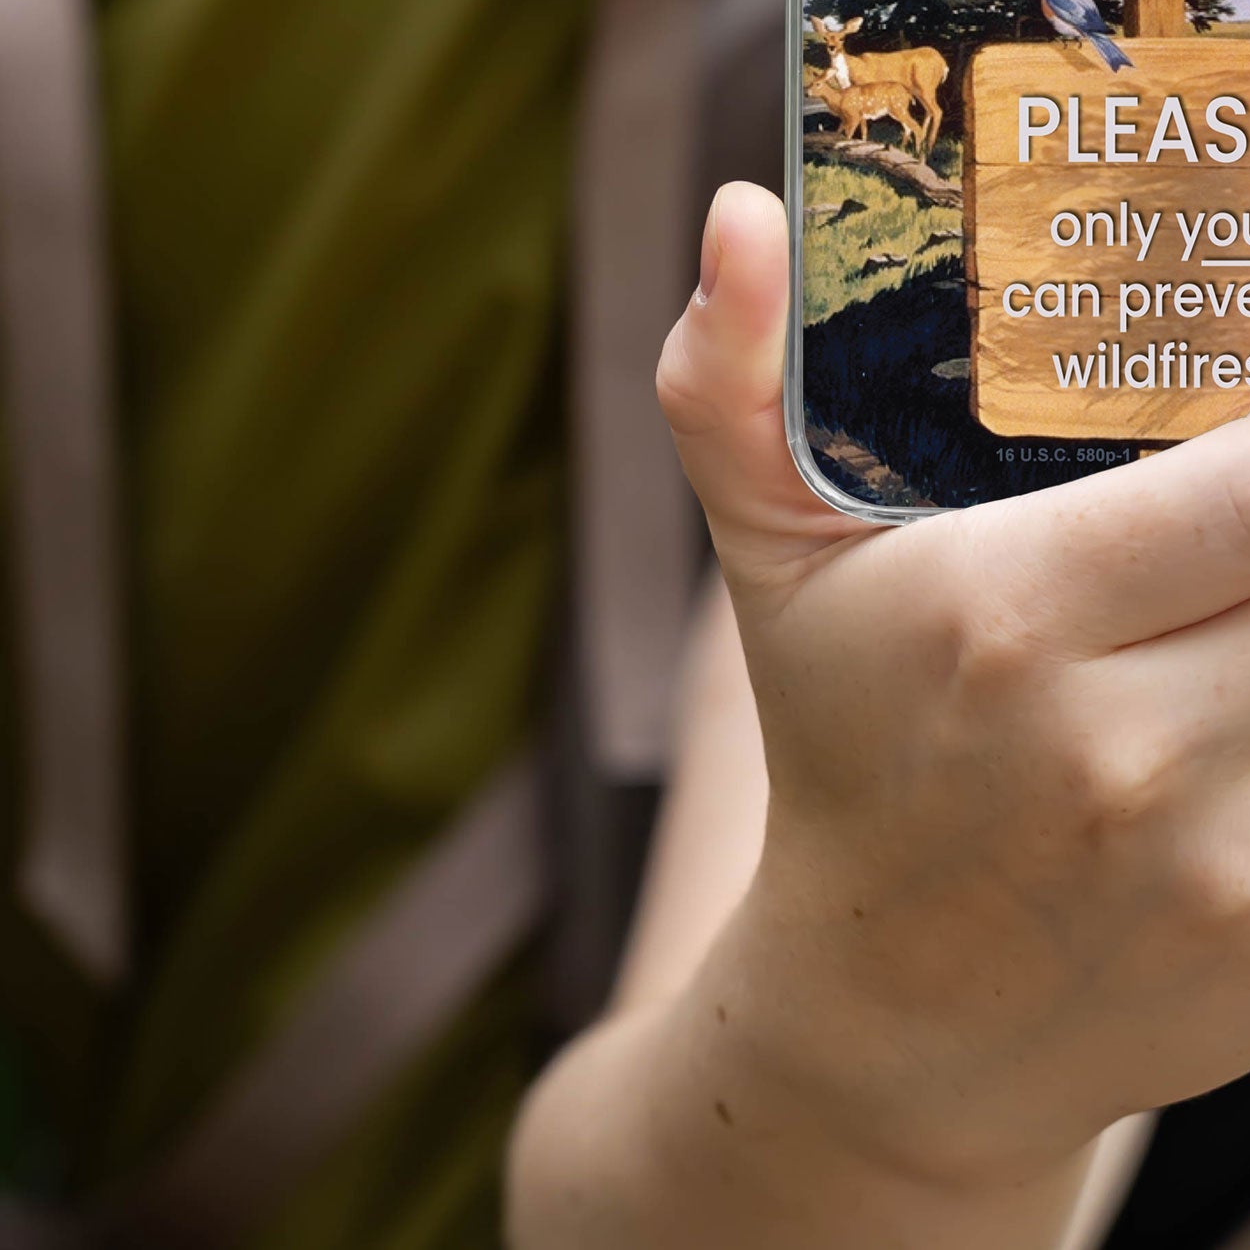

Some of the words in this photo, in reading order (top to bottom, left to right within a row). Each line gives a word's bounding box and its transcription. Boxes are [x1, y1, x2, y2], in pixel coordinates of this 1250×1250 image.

[1050, 202, 1161, 262] only
[1002, 281, 1101, 319] can
[996, 448, 1014, 462] 16
[1020, 448, 1071, 462] U.S.C.
[1076, 448, 1130, 465] 580p-1
